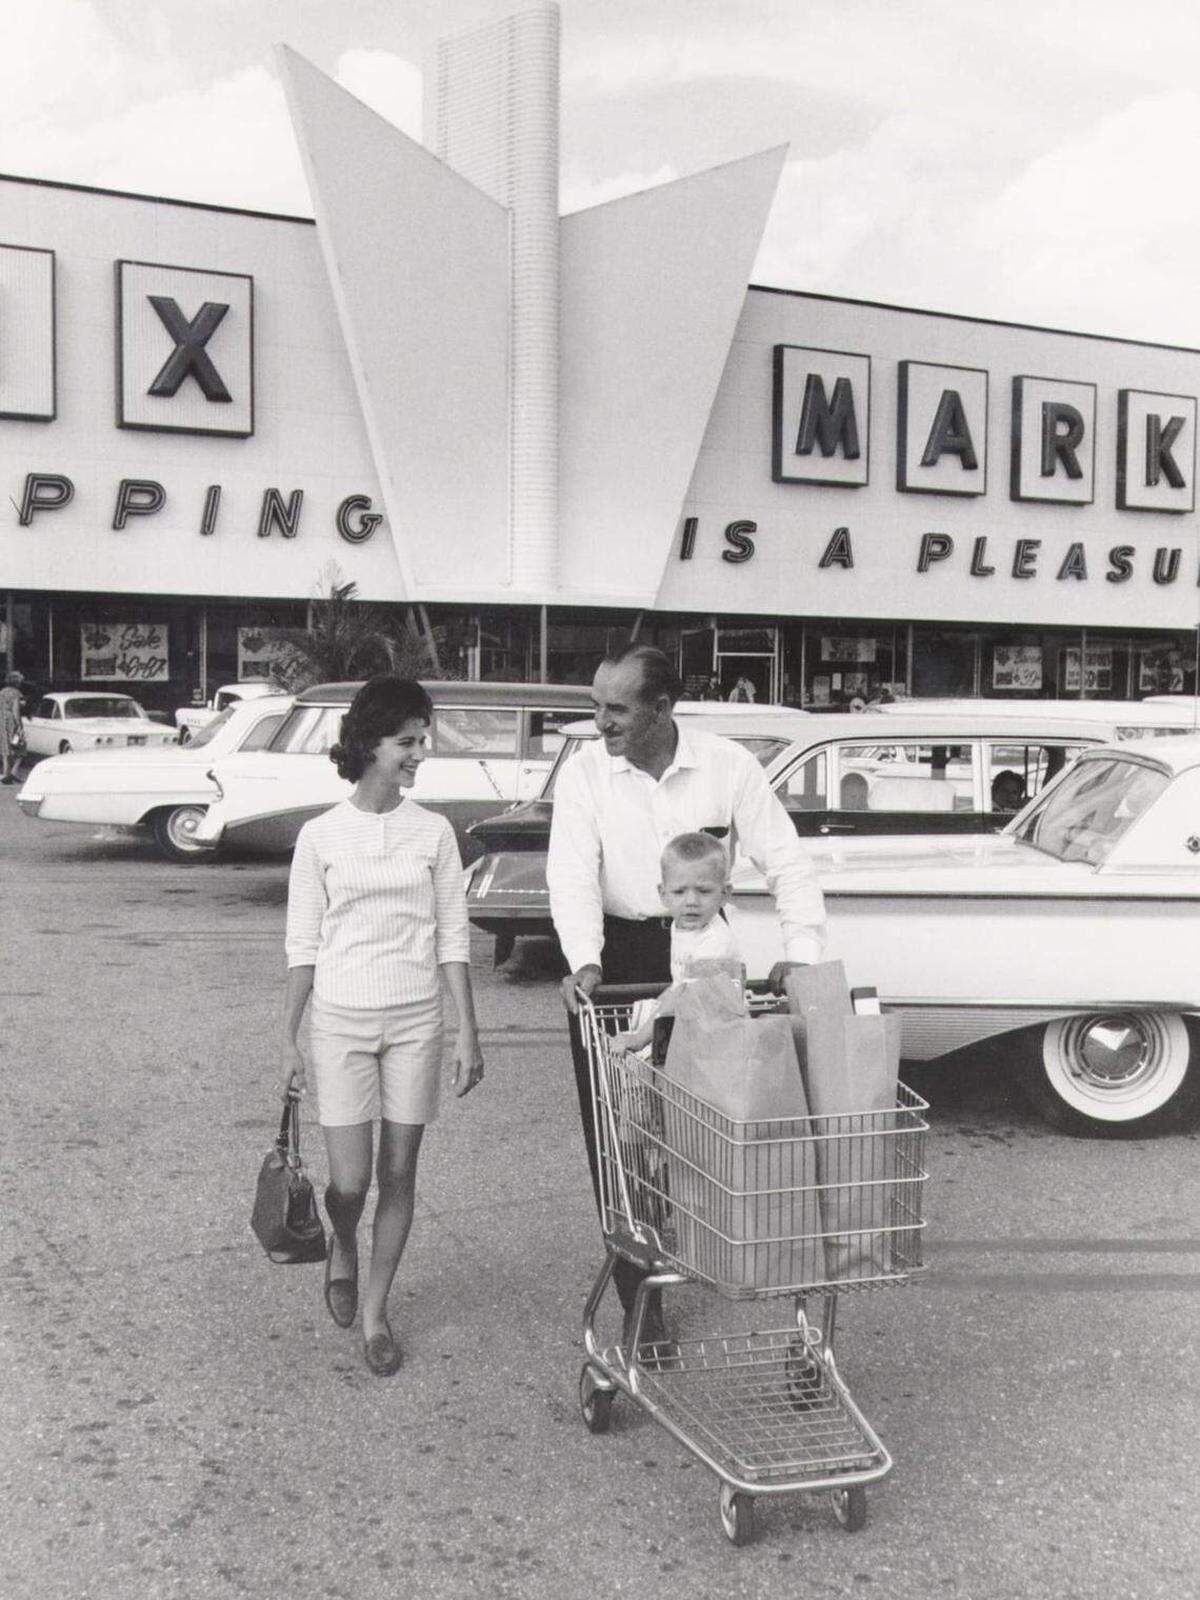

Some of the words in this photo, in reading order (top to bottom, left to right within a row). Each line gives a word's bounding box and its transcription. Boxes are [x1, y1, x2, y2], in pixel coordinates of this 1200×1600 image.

[146, 295, 233, 403] X
[795, 373, 1187, 490] MARK
[19, 472, 384, 545] PPING
[680, 517, 757, 563] IS
[819, 527, 855, 569] A
[917, 532, 1200, 588] PLEASU
